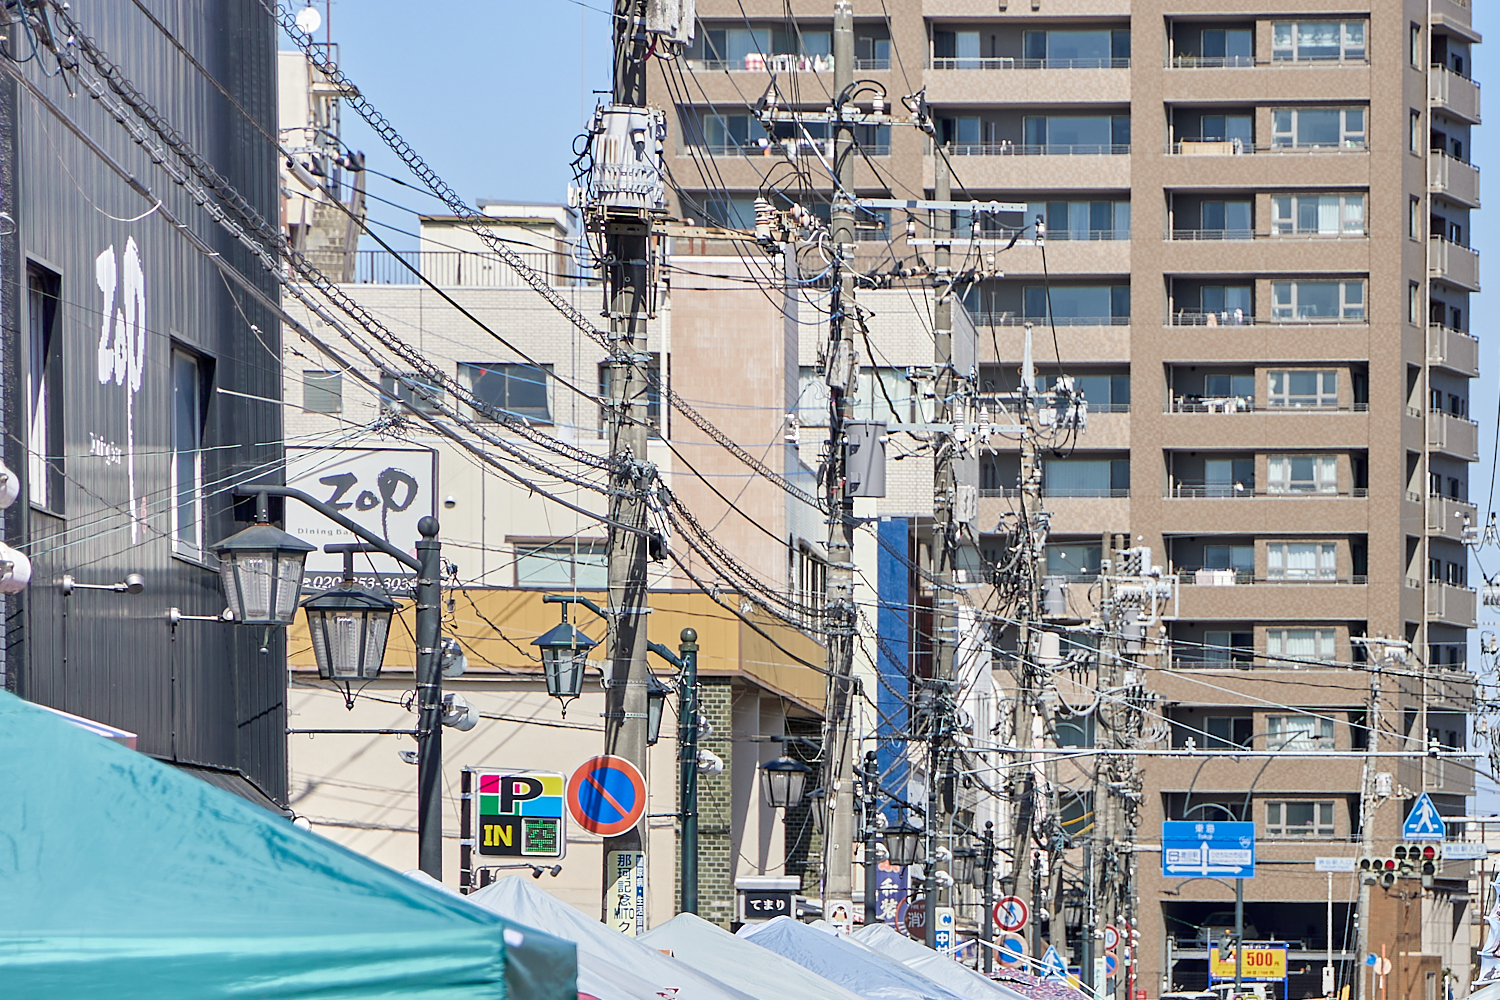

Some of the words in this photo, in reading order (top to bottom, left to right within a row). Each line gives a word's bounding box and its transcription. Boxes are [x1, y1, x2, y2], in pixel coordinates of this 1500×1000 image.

[297, 528, 333, 536] Dining
[500, 776, 543, 813] P
[483, 824, 513, 848] IN
[525, 819, 557, 852] 空
[750, 899, 786, 911] てまり
